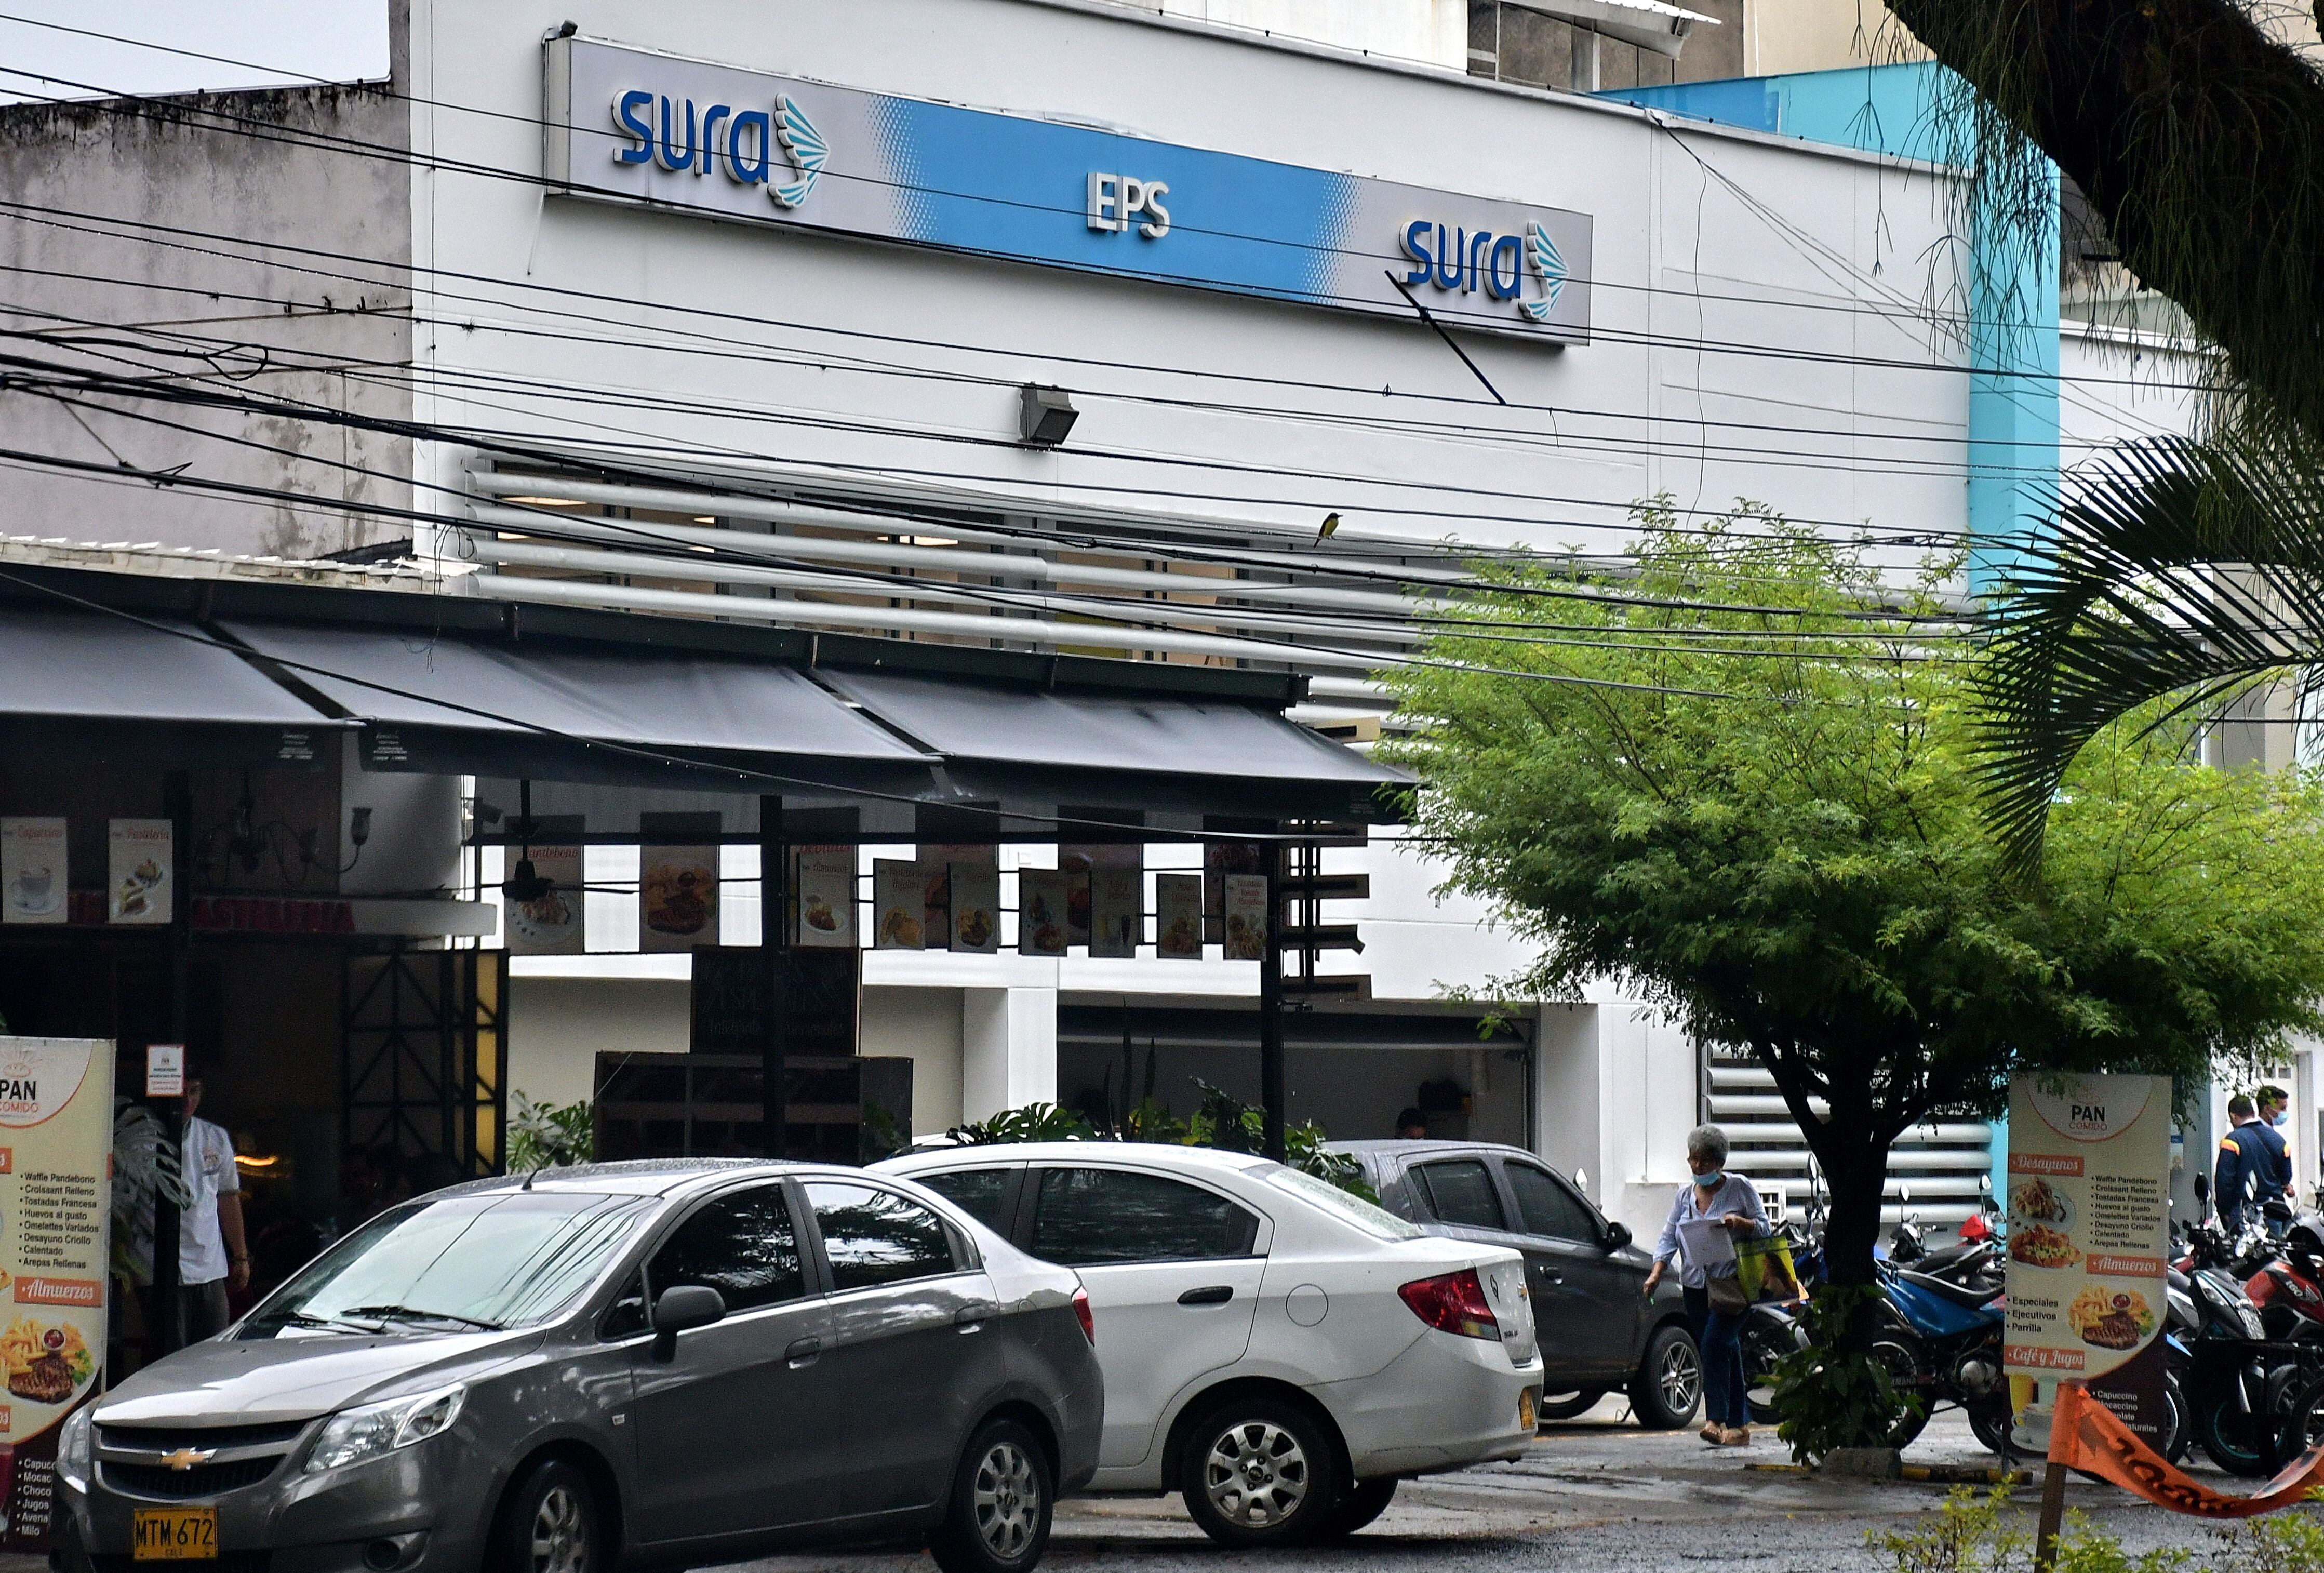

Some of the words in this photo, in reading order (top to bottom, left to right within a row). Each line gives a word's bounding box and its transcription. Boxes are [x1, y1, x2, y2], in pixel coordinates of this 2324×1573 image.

[612, 89, 769, 184] sura
[1087, 172, 1170, 238] EPS
[1399, 220, 1522, 300] sura
[0, 1079, 36, 1101] PAN
[0, 1101, 39, 1113] OMIDO
[2071, 1104, 2105, 1122] PAN
[2069, 1121, 2107, 1131] COMIDO
[2018, 1154, 2078, 1172] Desayunos
[24, 1172, 48, 1181] Waffle
[50, 1174, 95, 1184] Pandebono
[2118, 1177, 2157, 1185] Pandebono
[25, 1184, 62, 1194] Croissant
[65, 1186, 95, 1196] Relleno
[2095, 1184, 2129, 1193] Croissant
[24, 1196, 59, 1206] Tostadas
[61, 1198, 97, 1208] Francesa
[2095, 1194, 2126, 1202] Tostadas
[2128, 1195, 2159, 1204] Francesa
[24, 1209, 54, 1218] Huevos
[65, 1212, 87, 1221] gusto
[2131, 1205, 2151, 1214] gusto
[24, 1221, 63, 1231] Omelettes
[65, 1223, 99, 1233] Variados
[2095, 1221, 2129, 1230] Desayuno
[24, 1233, 63, 1244] Desayuno
[65, 1234, 91, 1245] Criollo
[2094, 1230, 2129, 1238] Calentado
[24, 1245, 63, 1256] Calentado
[2120, 1241, 2149, 1249] Rellenas
[23, 1257, 50, 1268] Arepas
[53, 1258, 86, 1269] Rellenas
[2099, 1256, 2156, 1272] Almuerzos
[28, 1279, 94, 1299] Almuerzos
[2012, 1296, 2059, 1308] Especiales
[2012, 1311, 2057, 1321] Ejecutivos
[2012, 1324, 2042, 1333] Parrilla
[2013, 1347, 2037, 1365] Café
[2040, 1352, 2047, 1366] y
[2050, 1349, 2083, 1368] Jugos
[2097, 1390, 2138, 1402] Capuccino
[2114, 1412, 2135, 1421] olate
[23, 1471, 51, 1483] Mocac
[23, 1484, 51, 1497] Choco
[22, 1498, 49, 1512] Jugos
[22, 1512, 48, 1523] Avena
[21, 1525, 40, 1536] Milo
[136, 1519, 171, 1547] MTM
[177, 1518, 213, 1545] 672
